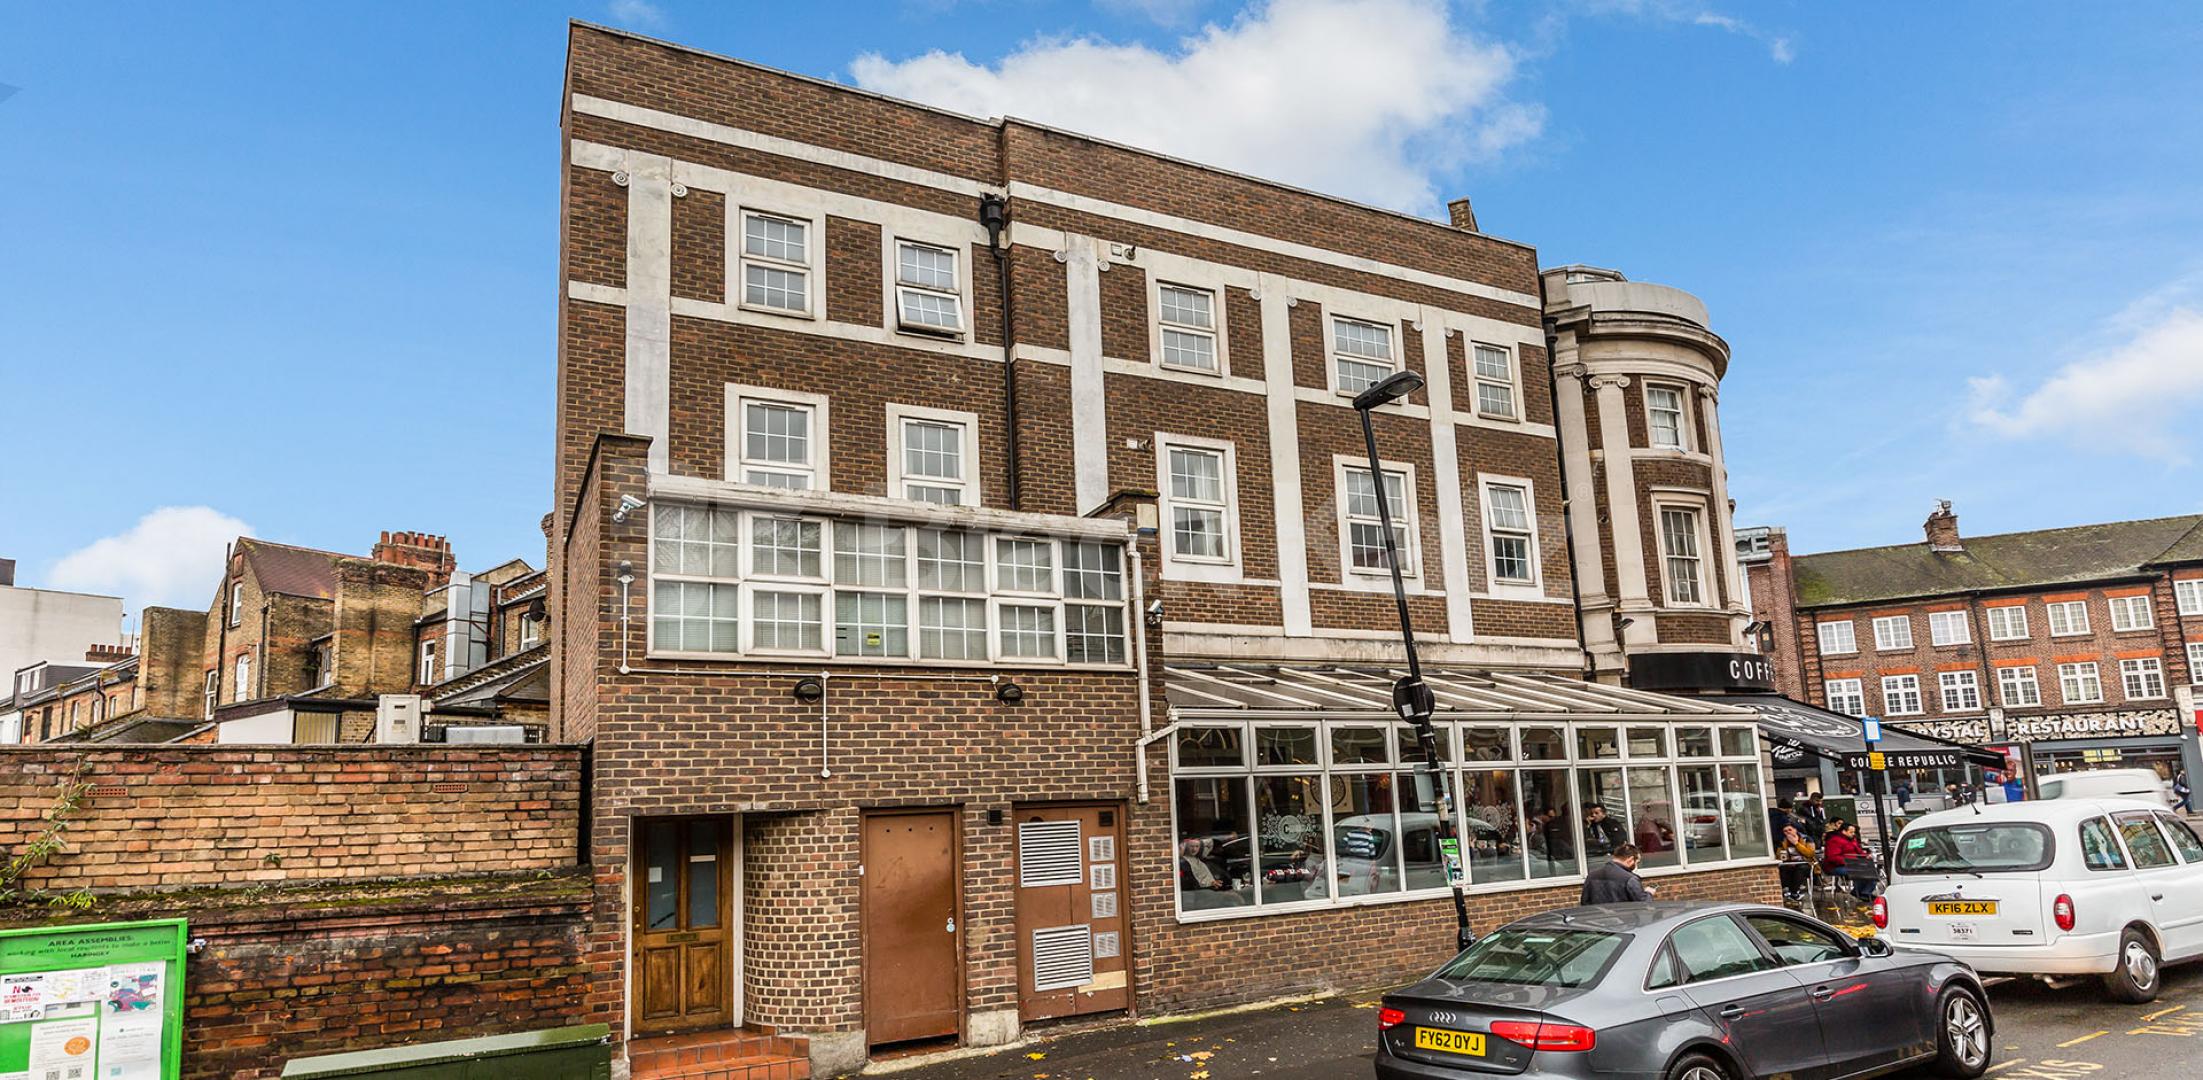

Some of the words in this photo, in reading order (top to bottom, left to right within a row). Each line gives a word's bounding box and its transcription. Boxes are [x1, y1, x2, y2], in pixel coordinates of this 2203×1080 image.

[1904, 723, 1985, 739] RYSTAL
[2017, 717, 2145, 734] RESTAURANT
[1898, 754, 1957, 767] REPUBLIC
[1935, 903, 1961, 913] KF16
[1964, 903, 1988, 913] ZLX
[48, 939, 75, 947] AREA
[1420, 1030, 1451, 1047] FY62
[1454, 1034, 1479, 1051] OYJ
